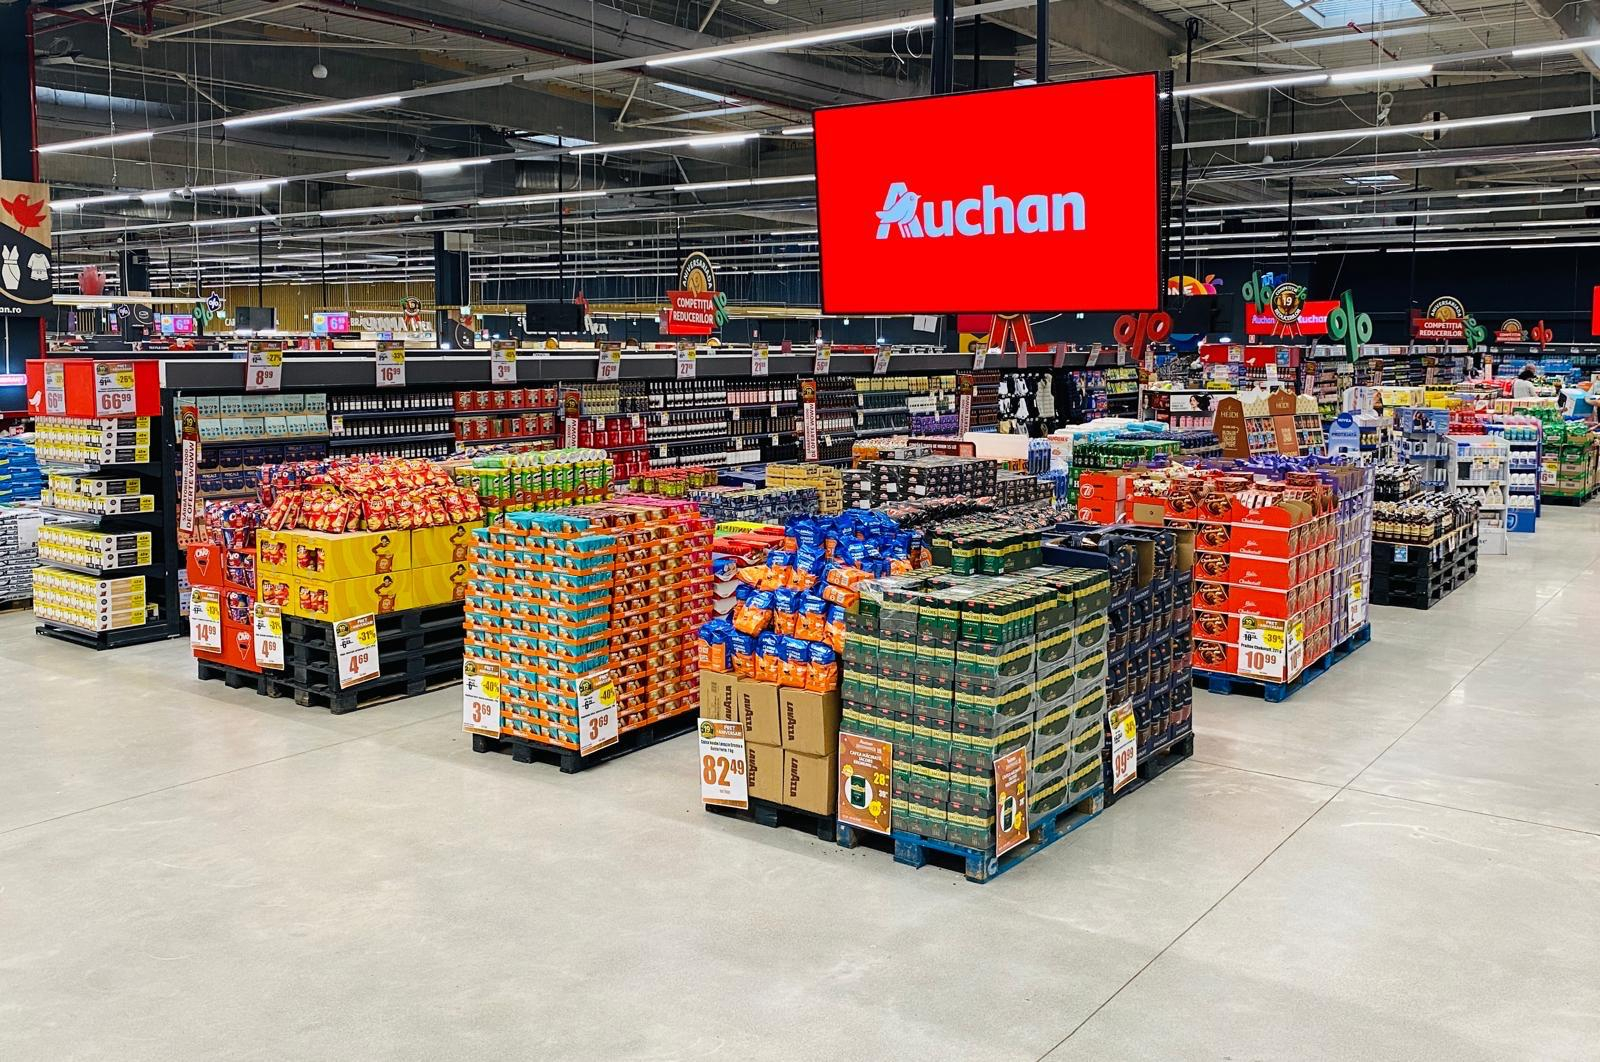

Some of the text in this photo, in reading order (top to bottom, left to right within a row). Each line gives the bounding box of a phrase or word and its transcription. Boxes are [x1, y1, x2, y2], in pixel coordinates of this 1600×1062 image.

[875, 182, 1085, 239] Auchan
[682, 259, 713, 289] ANIVERSARIADA
[1283, 297, 1292, 306] 19
[1430, 300, 1462, 317] ANIVERSARIADA
[673, 311, 714, 325] REDUCERILOR
[1252, 315, 1276, 324] Auchan
[186, 419, 193, 427] 19
[187, 517, 192, 529] DE
[196, 624, 216, 641] 1499
[359, 630, 376, 641] -31%
[1265, 634, 1284, 644] -39%
[262, 640, 277, 658] 469
[349, 653, 368, 673] 469
[1245, 651, 1277, 670] 1099
[483, 681, 499, 692] -40%
[601, 687, 614, 700] -40%
[473, 702, 491, 722] 369
[589, 714, 609, 740] 369
[703, 755, 744, 786] 8249
